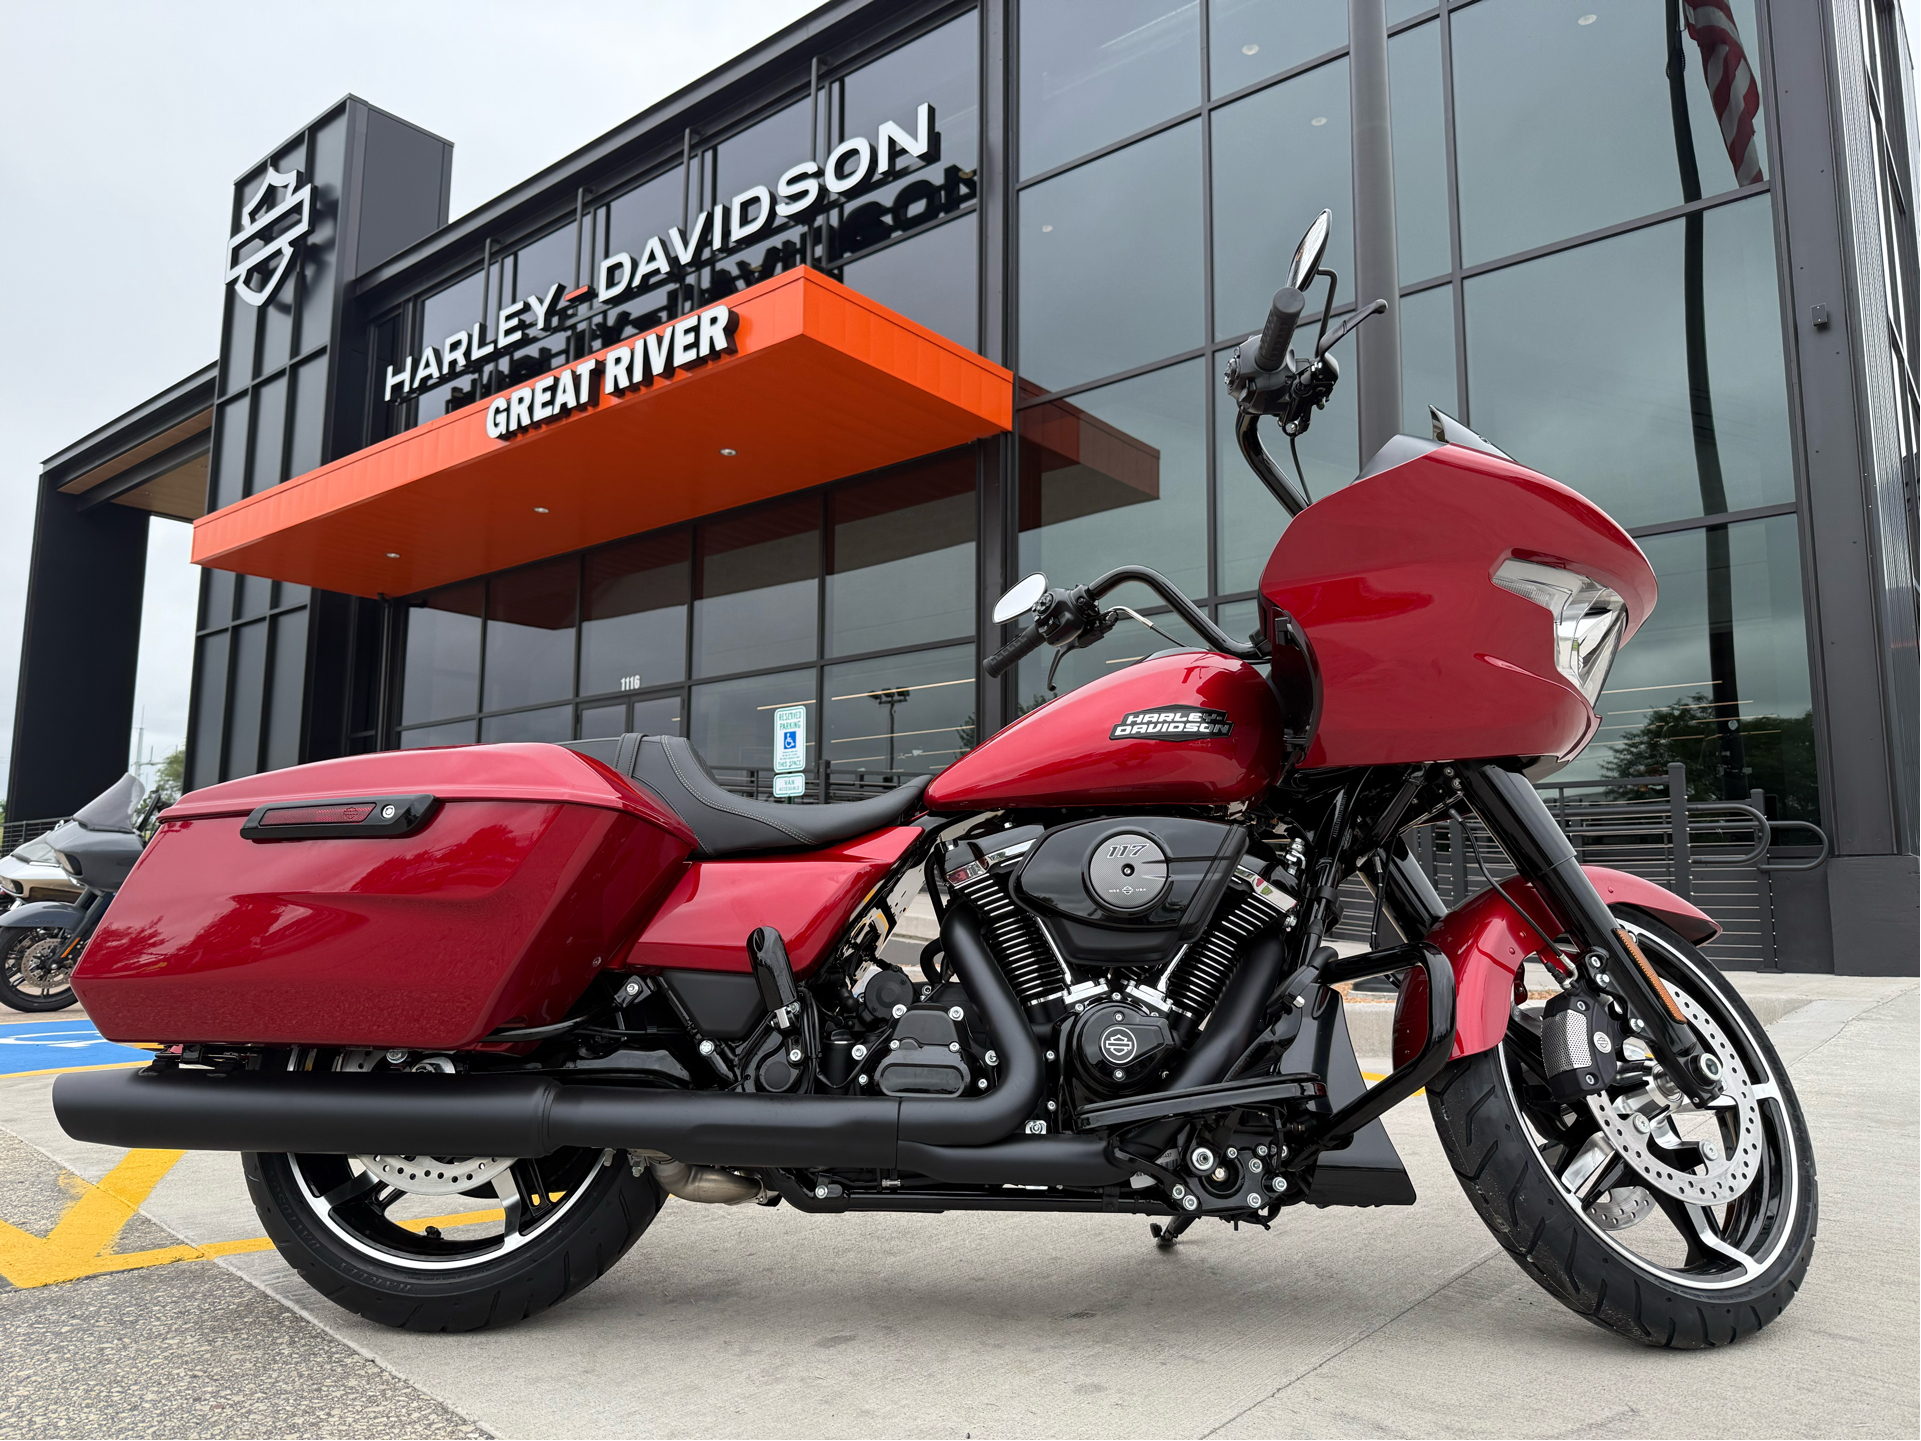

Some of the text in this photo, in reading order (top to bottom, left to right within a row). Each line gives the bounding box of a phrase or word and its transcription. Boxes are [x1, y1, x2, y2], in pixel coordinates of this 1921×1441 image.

[384, 102, 934, 402] HARLEY-DAVIDSON
[486, 304, 734, 440] GREAT RIVER
[620, 675, 641, 691] 1116
[779, 711, 802, 722] RESERVED
[779, 720, 802, 731] PARKING
[1114, 722, 1230, 736] DAVIDSON
[789, 759, 802, 768] SPACE
[1107, 843, 1150, 858] 117
